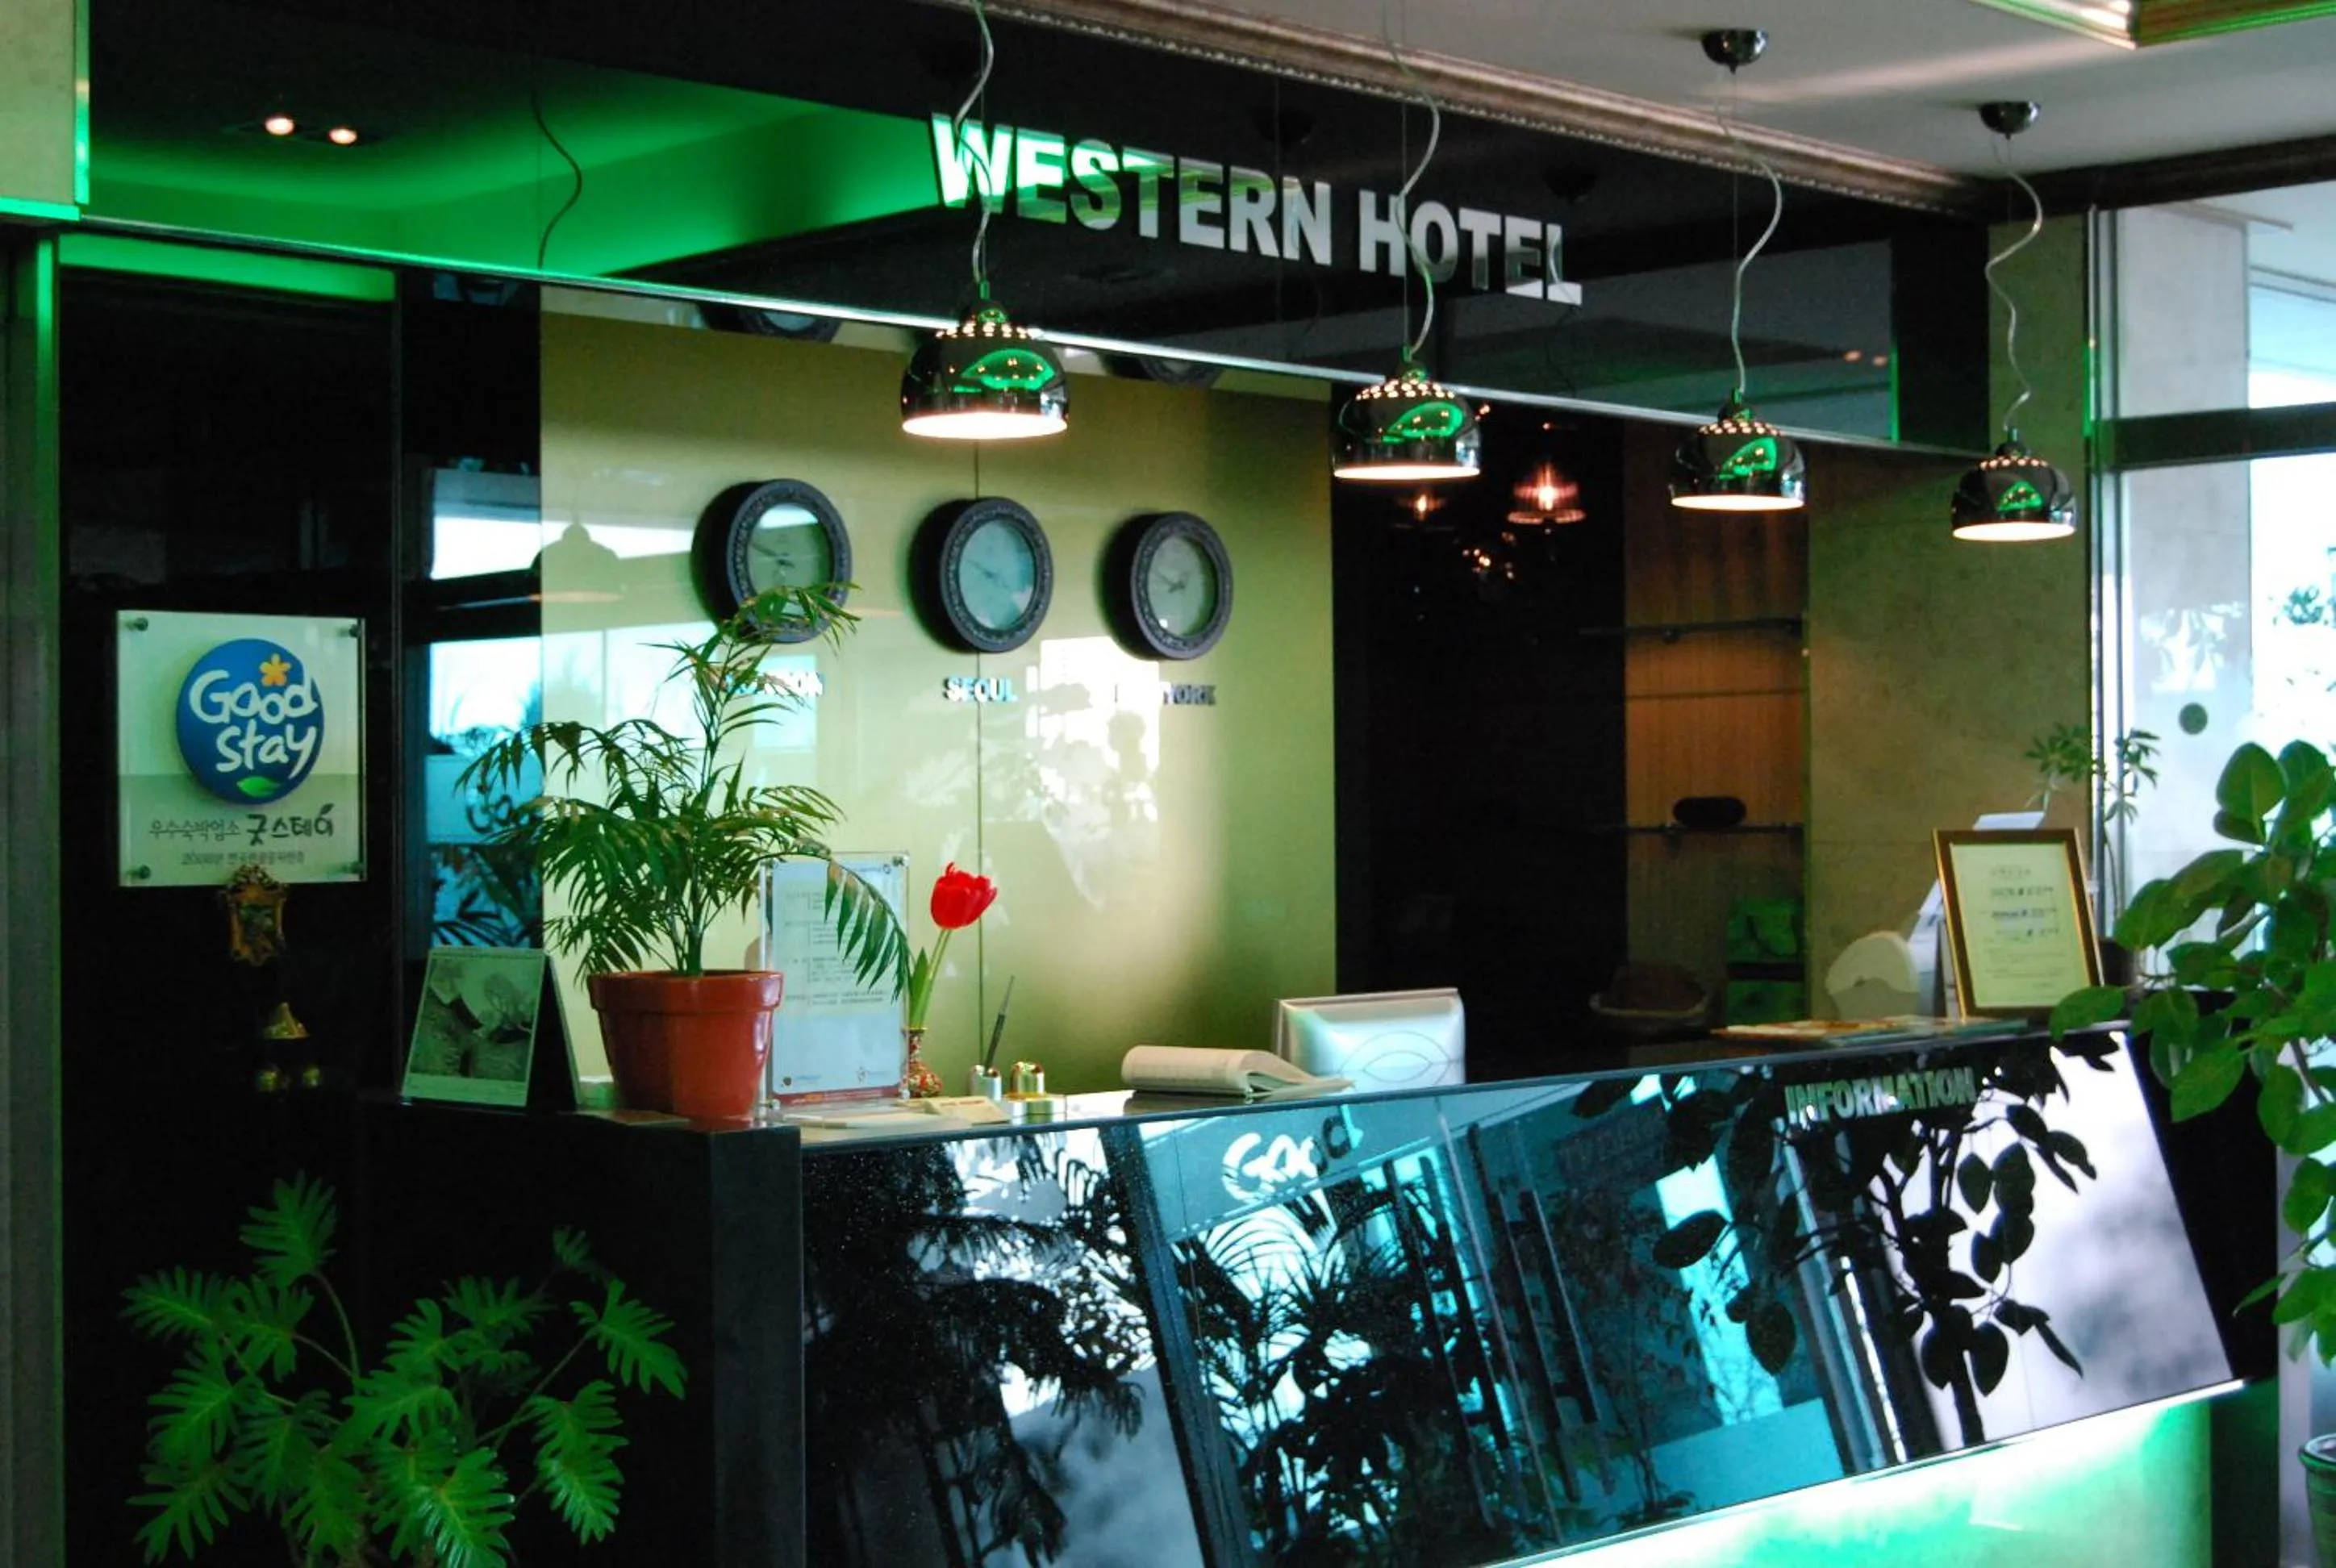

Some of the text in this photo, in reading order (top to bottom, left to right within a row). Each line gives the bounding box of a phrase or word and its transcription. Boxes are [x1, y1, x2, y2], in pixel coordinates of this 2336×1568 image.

[931, 113, 1583, 307] WESTERN HOTEL
[189, 663, 319, 724] Good
[941, 676, 1017, 702] SEOUL
[1162, 683, 1216, 705] YORK
[246, 803, 335, 846] 굿스테이
[1784, 1066, 1976, 1129] INFORMATION
